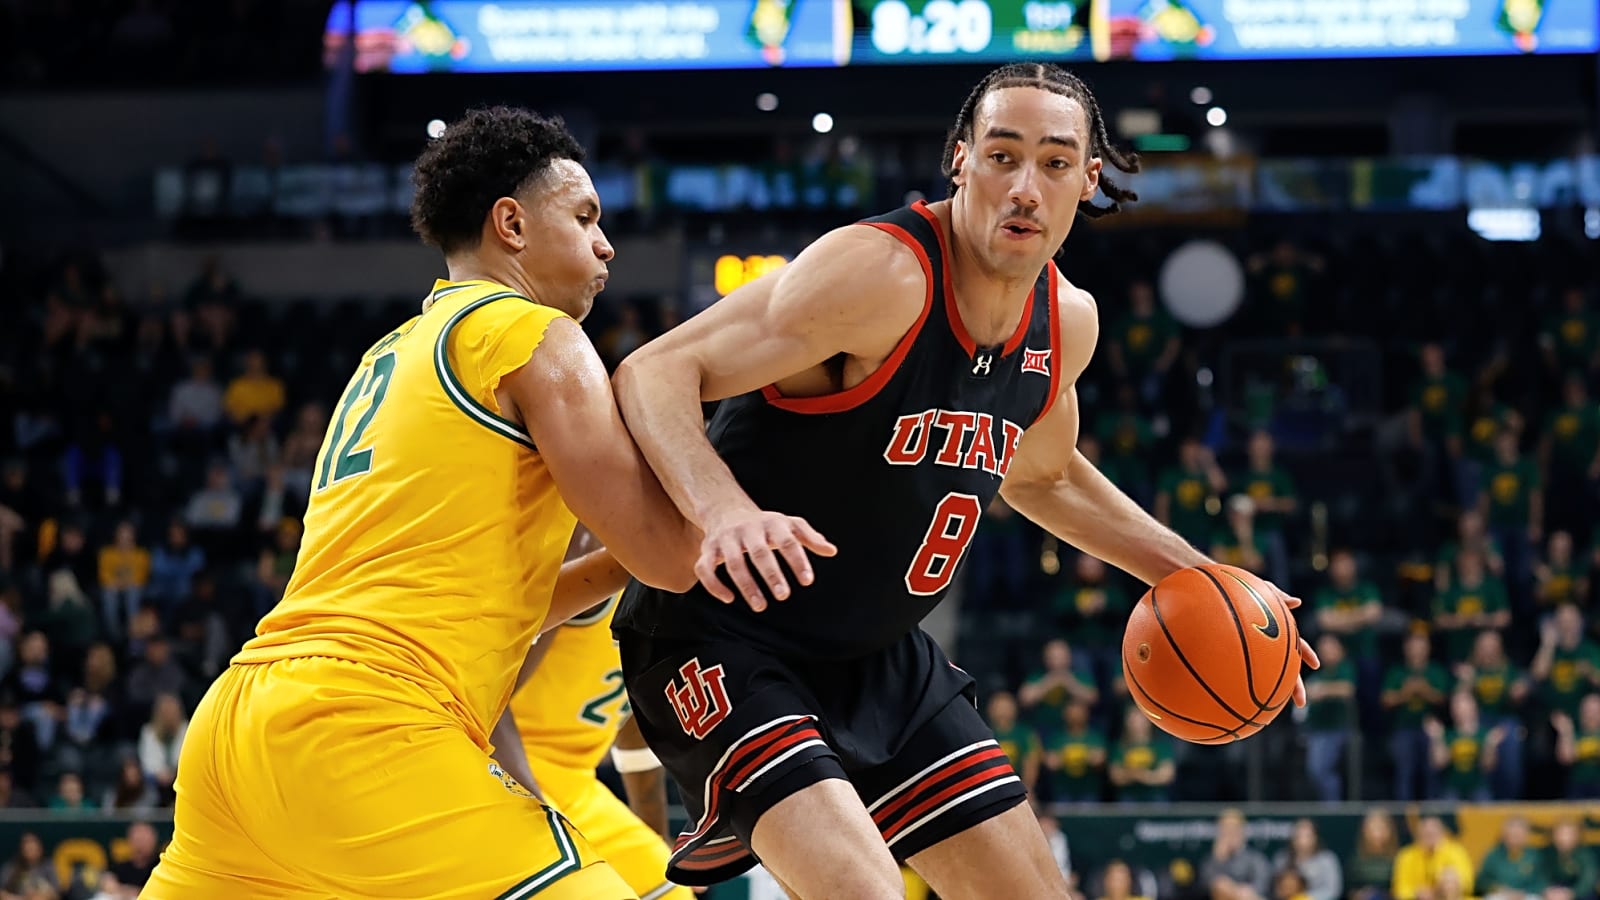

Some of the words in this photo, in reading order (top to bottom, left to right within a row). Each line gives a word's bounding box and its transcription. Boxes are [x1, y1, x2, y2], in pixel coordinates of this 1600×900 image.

[872, 0, 992, 53] 8:20
[1022, 347, 1052, 376] XII
[316, 349, 397, 493] 12
[905, 492, 982, 595] 8
